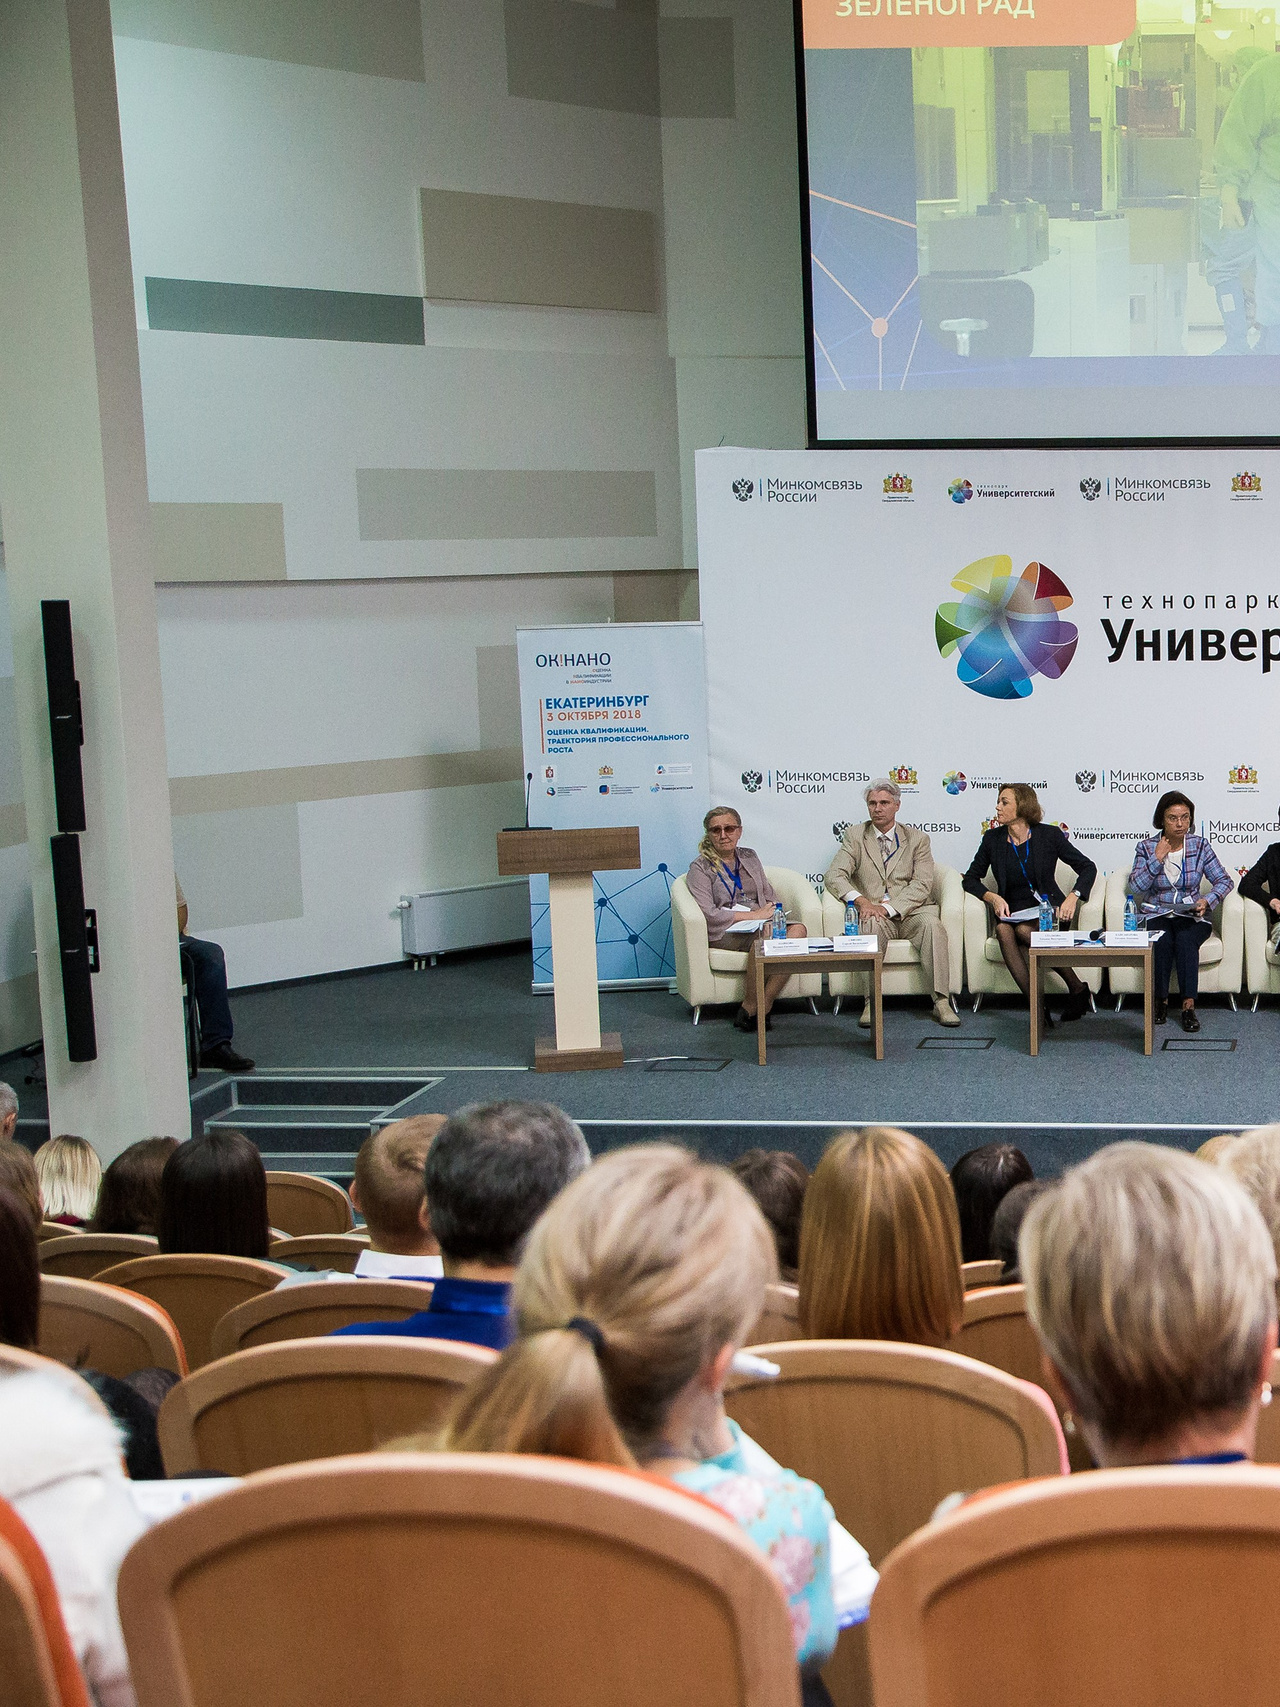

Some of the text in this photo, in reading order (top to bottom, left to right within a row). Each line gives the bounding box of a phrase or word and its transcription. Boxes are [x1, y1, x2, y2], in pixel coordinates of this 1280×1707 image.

[767, 490, 817, 503] России
[976, 488, 1055, 499] Университетский
[1115, 488, 1165, 501] России
[1102, 593, 1280, 614] технопарк
[535, 652, 612, 668] ОК!НАНО
[545, 695, 650, 710] ЕКАТЕРИНБУРГ
[546, 710, 642, 722] 3 ОКТЯБРЯ 2018
[546, 726, 649, 736] ОЦЕНКА КВАЛИФИКАЦИИ.
[547, 734, 690, 745] ТРАЕКТОРИЯ ПРОФЕССИОНАЛЬНОГО
[548, 746, 574, 754] РОСТА
[776, 781, 825, 794] России
[1110, 781, 1159, 794] России
[1210, 820, 1280, 831] Минкомсв
[1073, 831, 1150, 842] Университетский
[1210, 832, 1258, 844] России
